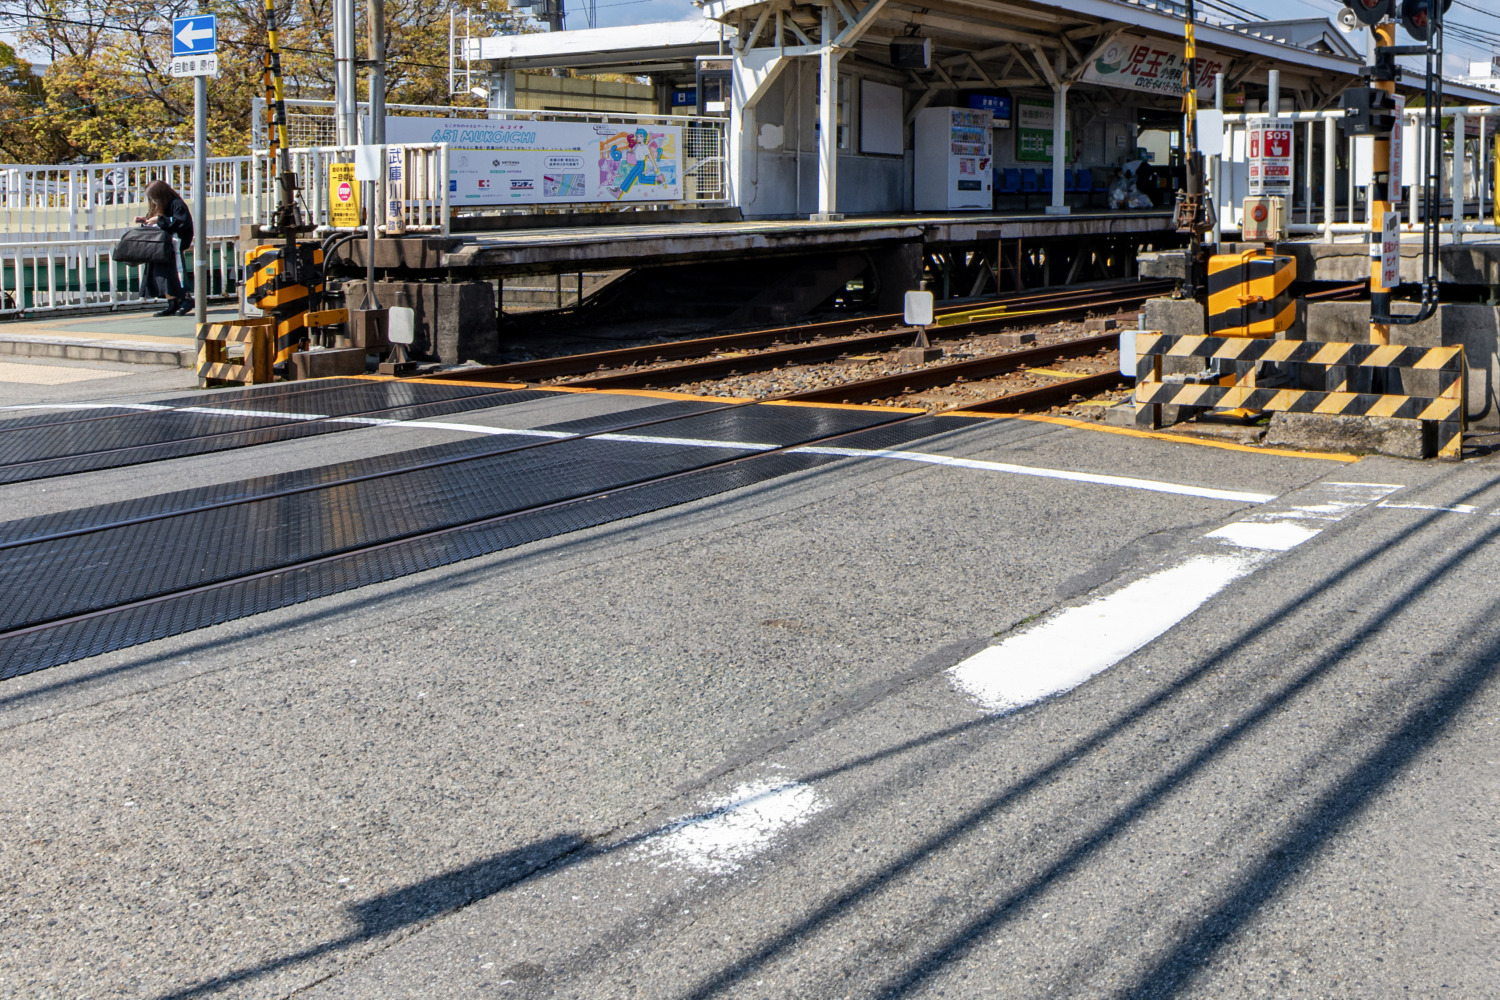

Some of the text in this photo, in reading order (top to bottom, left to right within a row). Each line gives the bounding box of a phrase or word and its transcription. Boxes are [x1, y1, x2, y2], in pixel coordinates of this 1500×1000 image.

[1120, 44, 1169, 78] 児玉
[431, 129, 536, 144] 651 MUKOICHI
[1267, 131, 1288, 140] SOS
[388, 147, 403, 217] 武庫川駅
